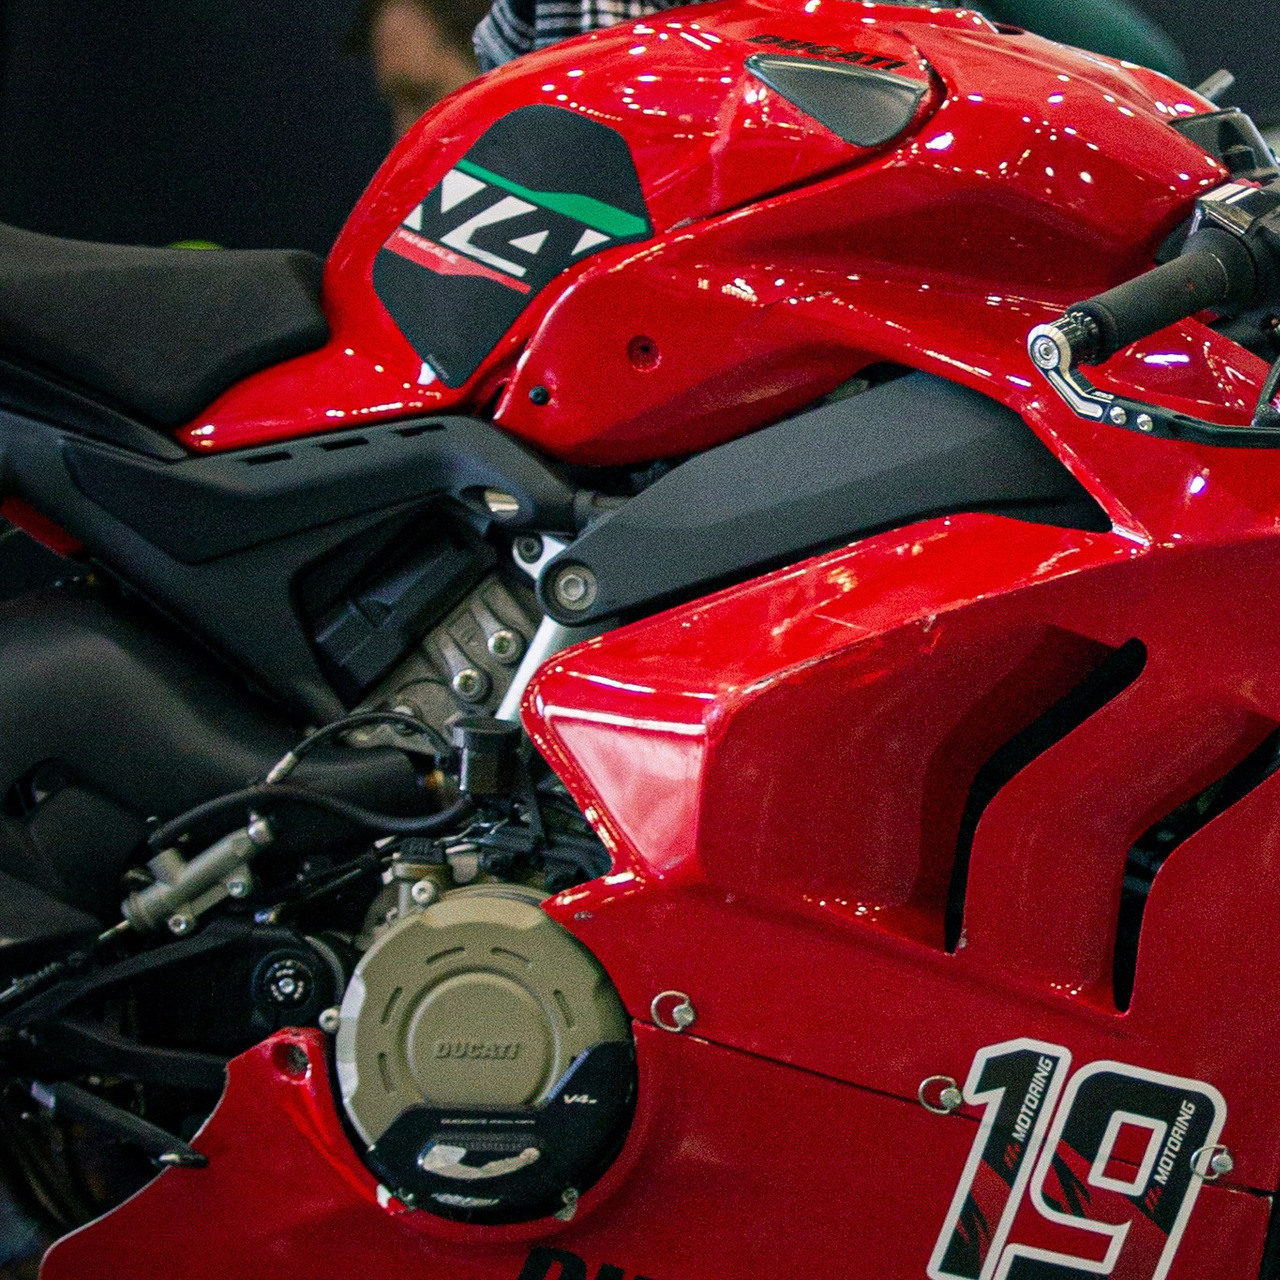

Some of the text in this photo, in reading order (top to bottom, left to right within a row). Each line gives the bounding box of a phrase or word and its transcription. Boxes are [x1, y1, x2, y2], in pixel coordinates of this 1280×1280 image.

[746, 34, 908, 70] DUCATI
[434, 1041, 523, 1061] DUCATI
[1011, 1056, 1053, 1142] MOTORING
[1153, 1100, 1196, 1185] MOTORING
